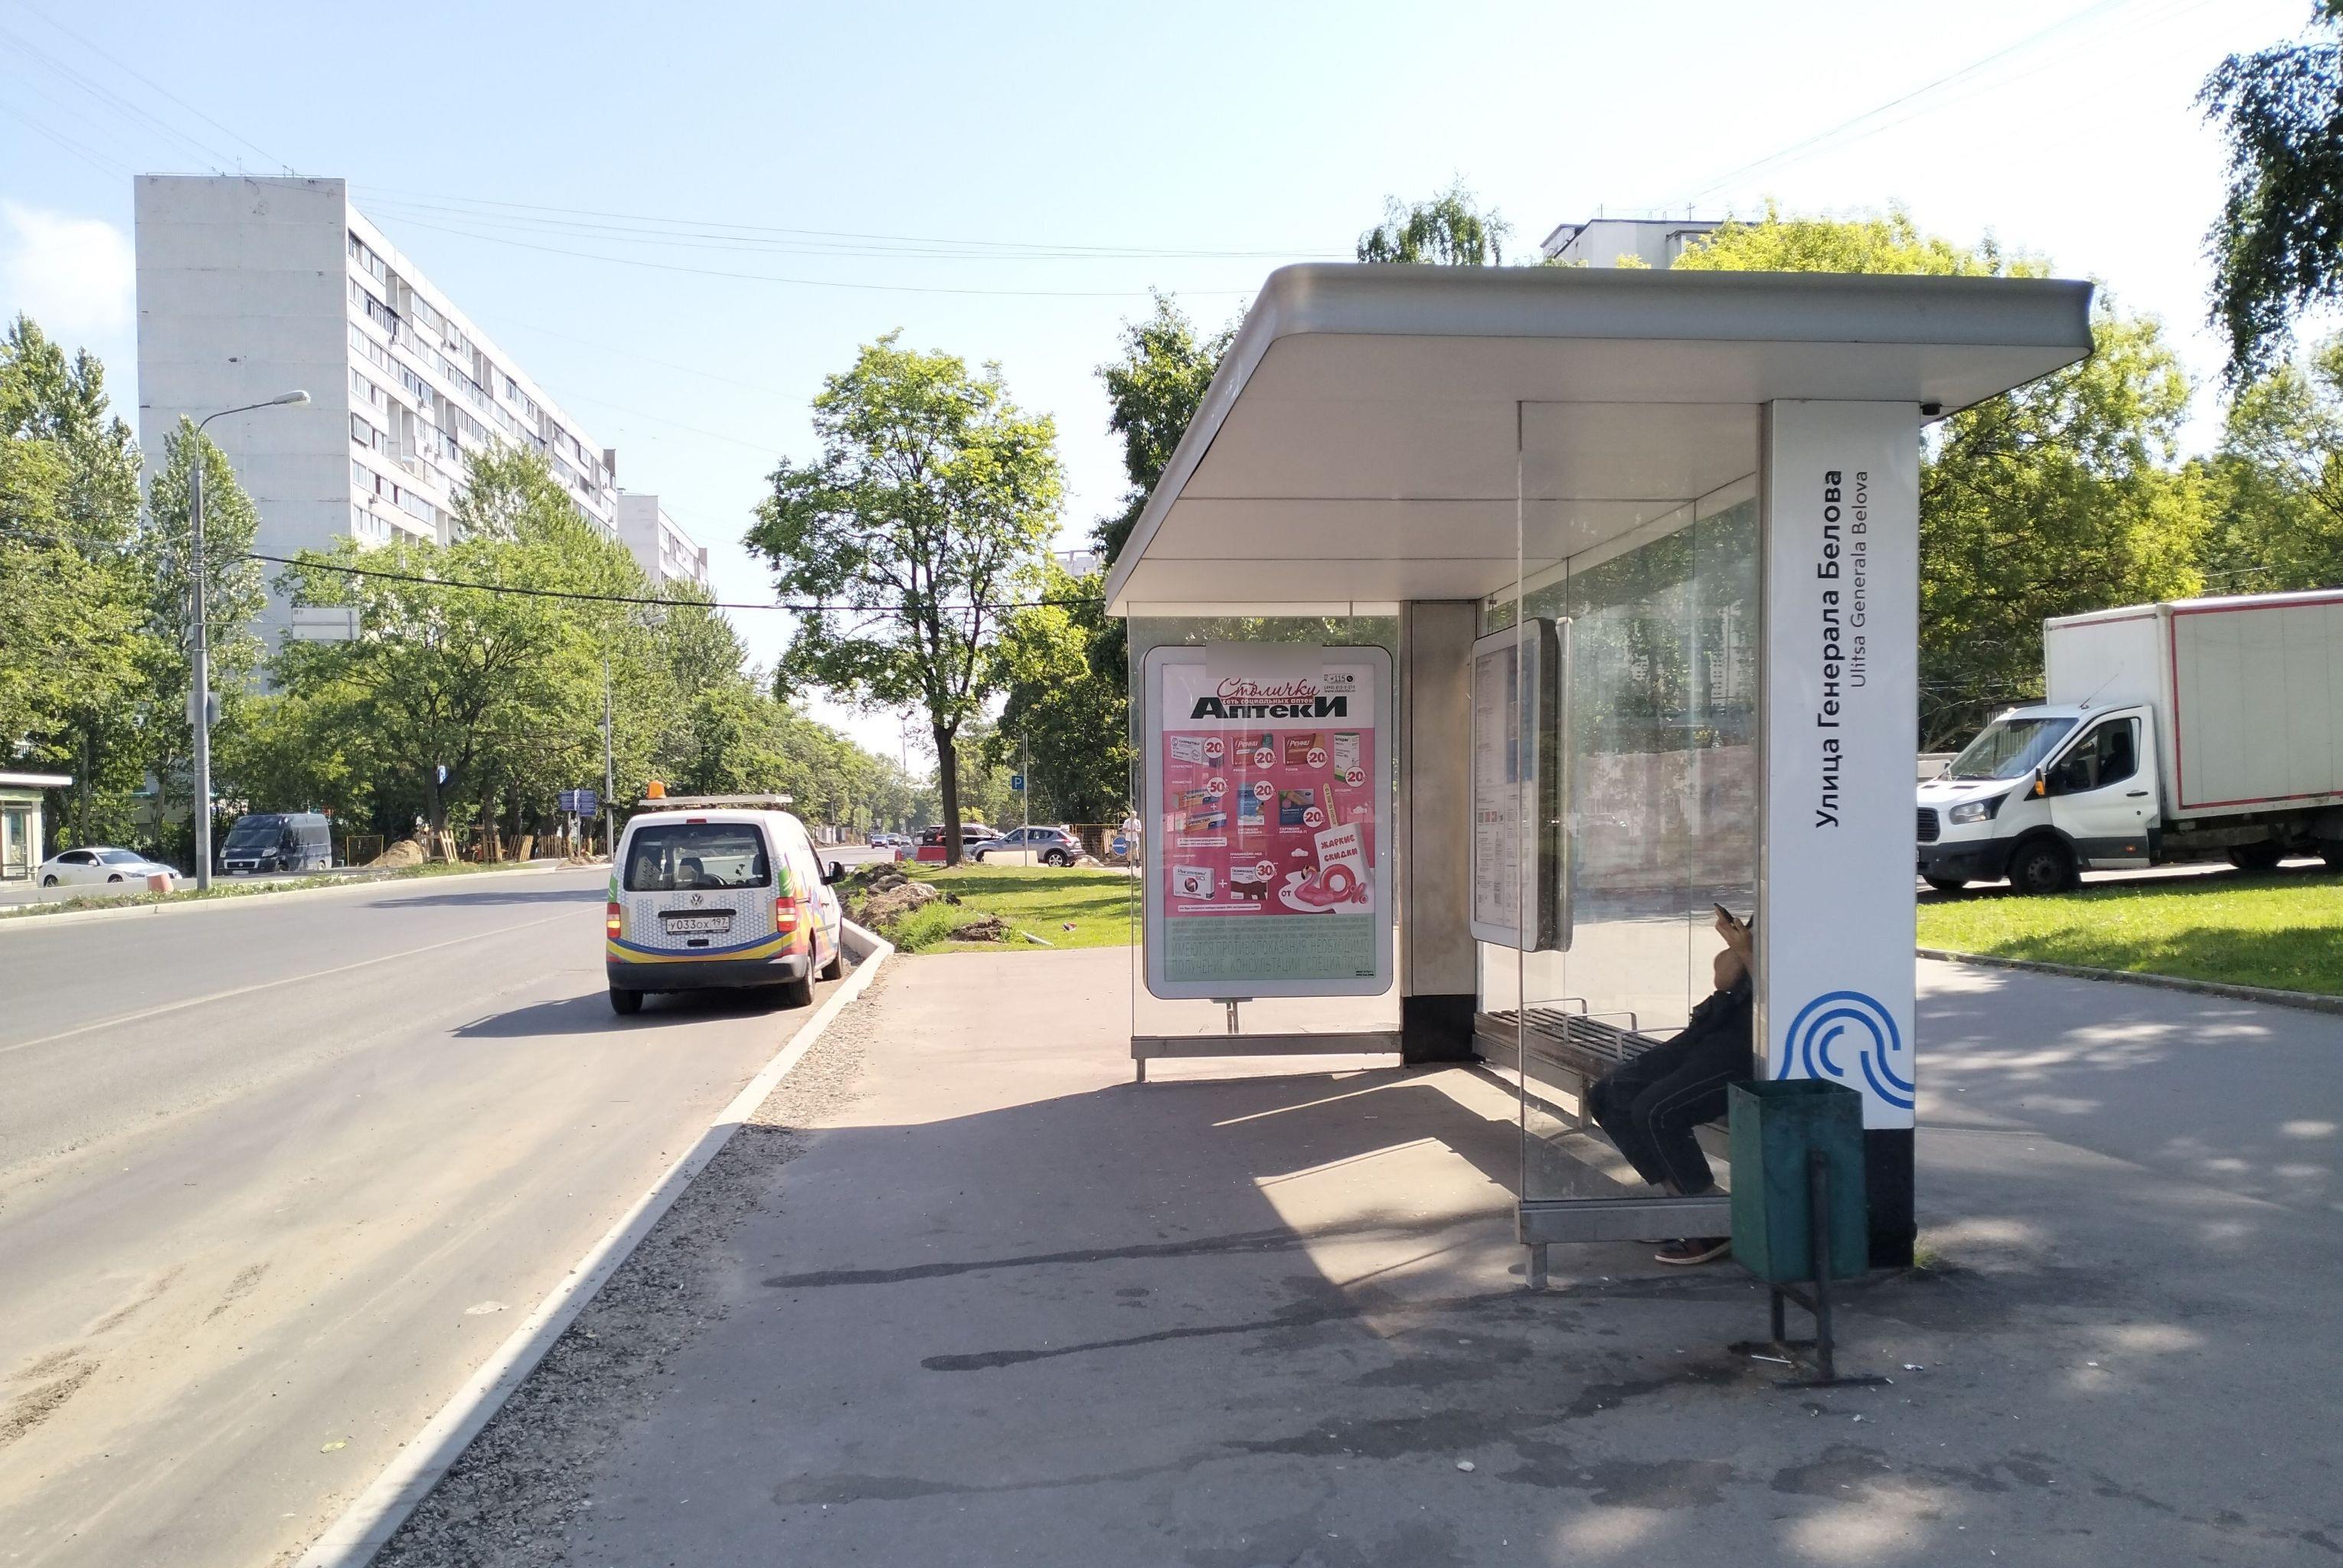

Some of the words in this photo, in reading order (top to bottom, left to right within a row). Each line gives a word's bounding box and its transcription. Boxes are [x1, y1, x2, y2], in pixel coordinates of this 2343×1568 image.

[1817, 470, 1842, 579] Белова
[1851, 471, 1868, 534] Belova
[1850, 541, 1867, 628] Generala
[1817, 590, 1846, 727] Генерала
[1850, 635, 1866, 688] Ulitsa
[1015, 777, 1022, 789] P
[1815, 739, 1844, 828] Улица
[1324, 848, 1358, 862] СКИДКИ
[711, 917, 726, 926] 197
